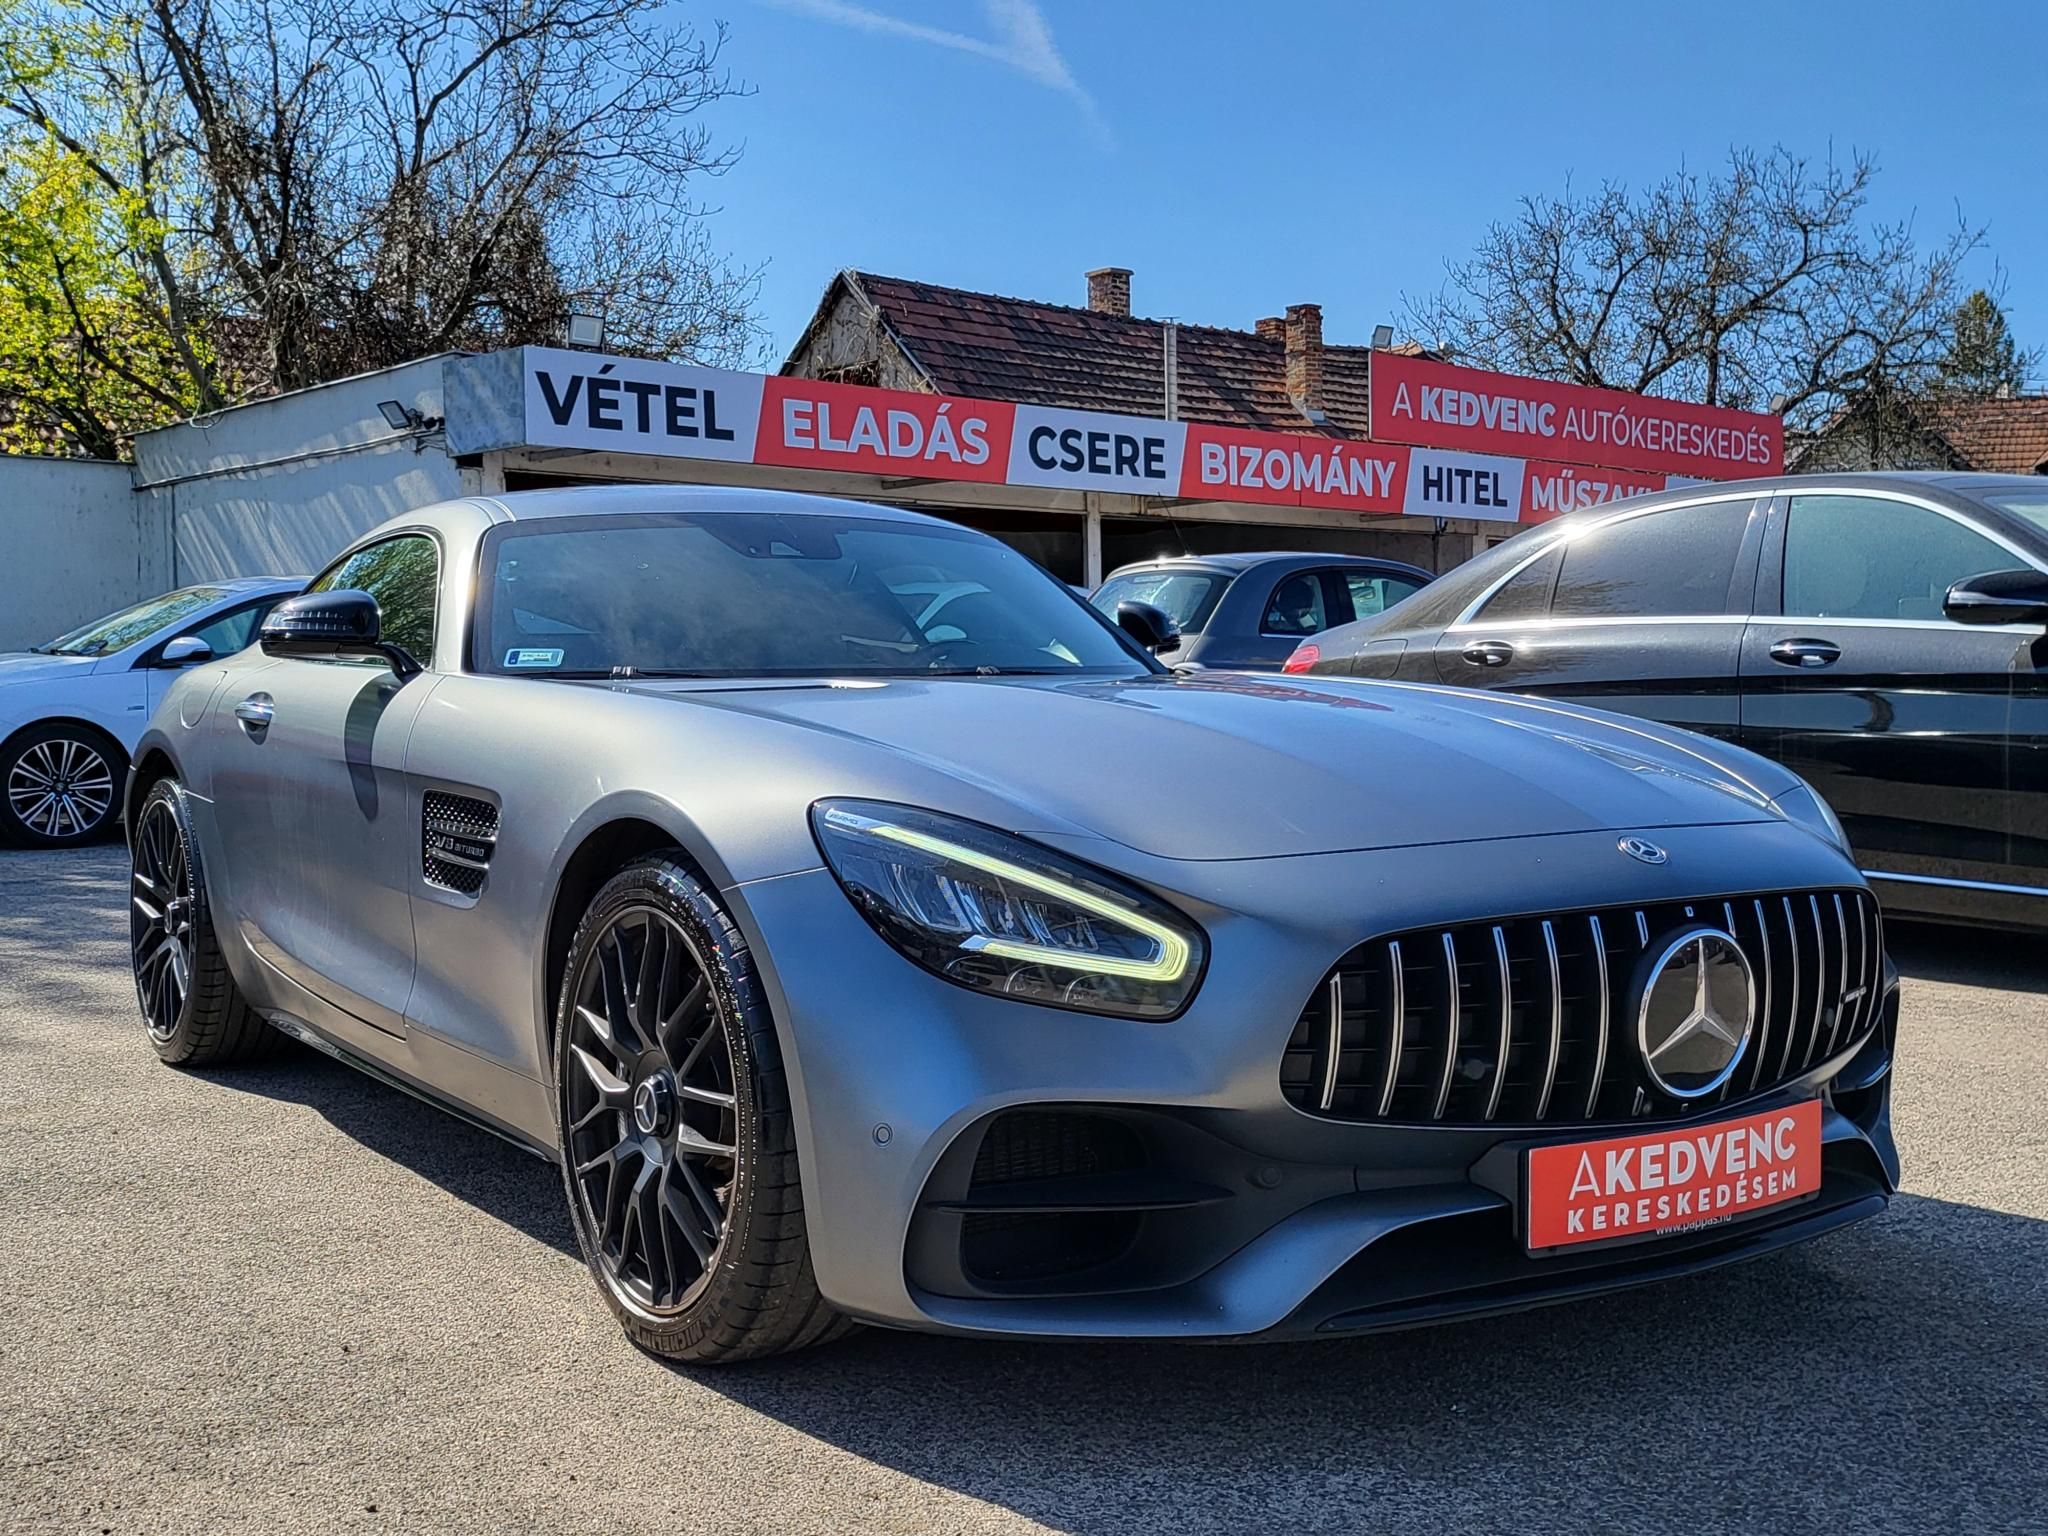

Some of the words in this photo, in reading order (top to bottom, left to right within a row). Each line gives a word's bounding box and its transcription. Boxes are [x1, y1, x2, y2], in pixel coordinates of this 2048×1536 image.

[535, 363, 735, 441] VÉTEL
[781, 398, 990, 465] ELADÁS
[1028, 425, 1167, 479] CSERE
[1200, 442, 1397, 498] BIZOMÁNY
[1422, 464, 1508, 508] HITEL
[1531, 468, 1653, 514] MŰSZ
[1391, 382, 1414, 420] A
[1420, 387, 1556, 438] KEDVENC
[1562, 405, 1771, 465] AUTÓKERESKEDÉS
[1567, 1166, 1797, 1234] KERESKEDÉSEM
